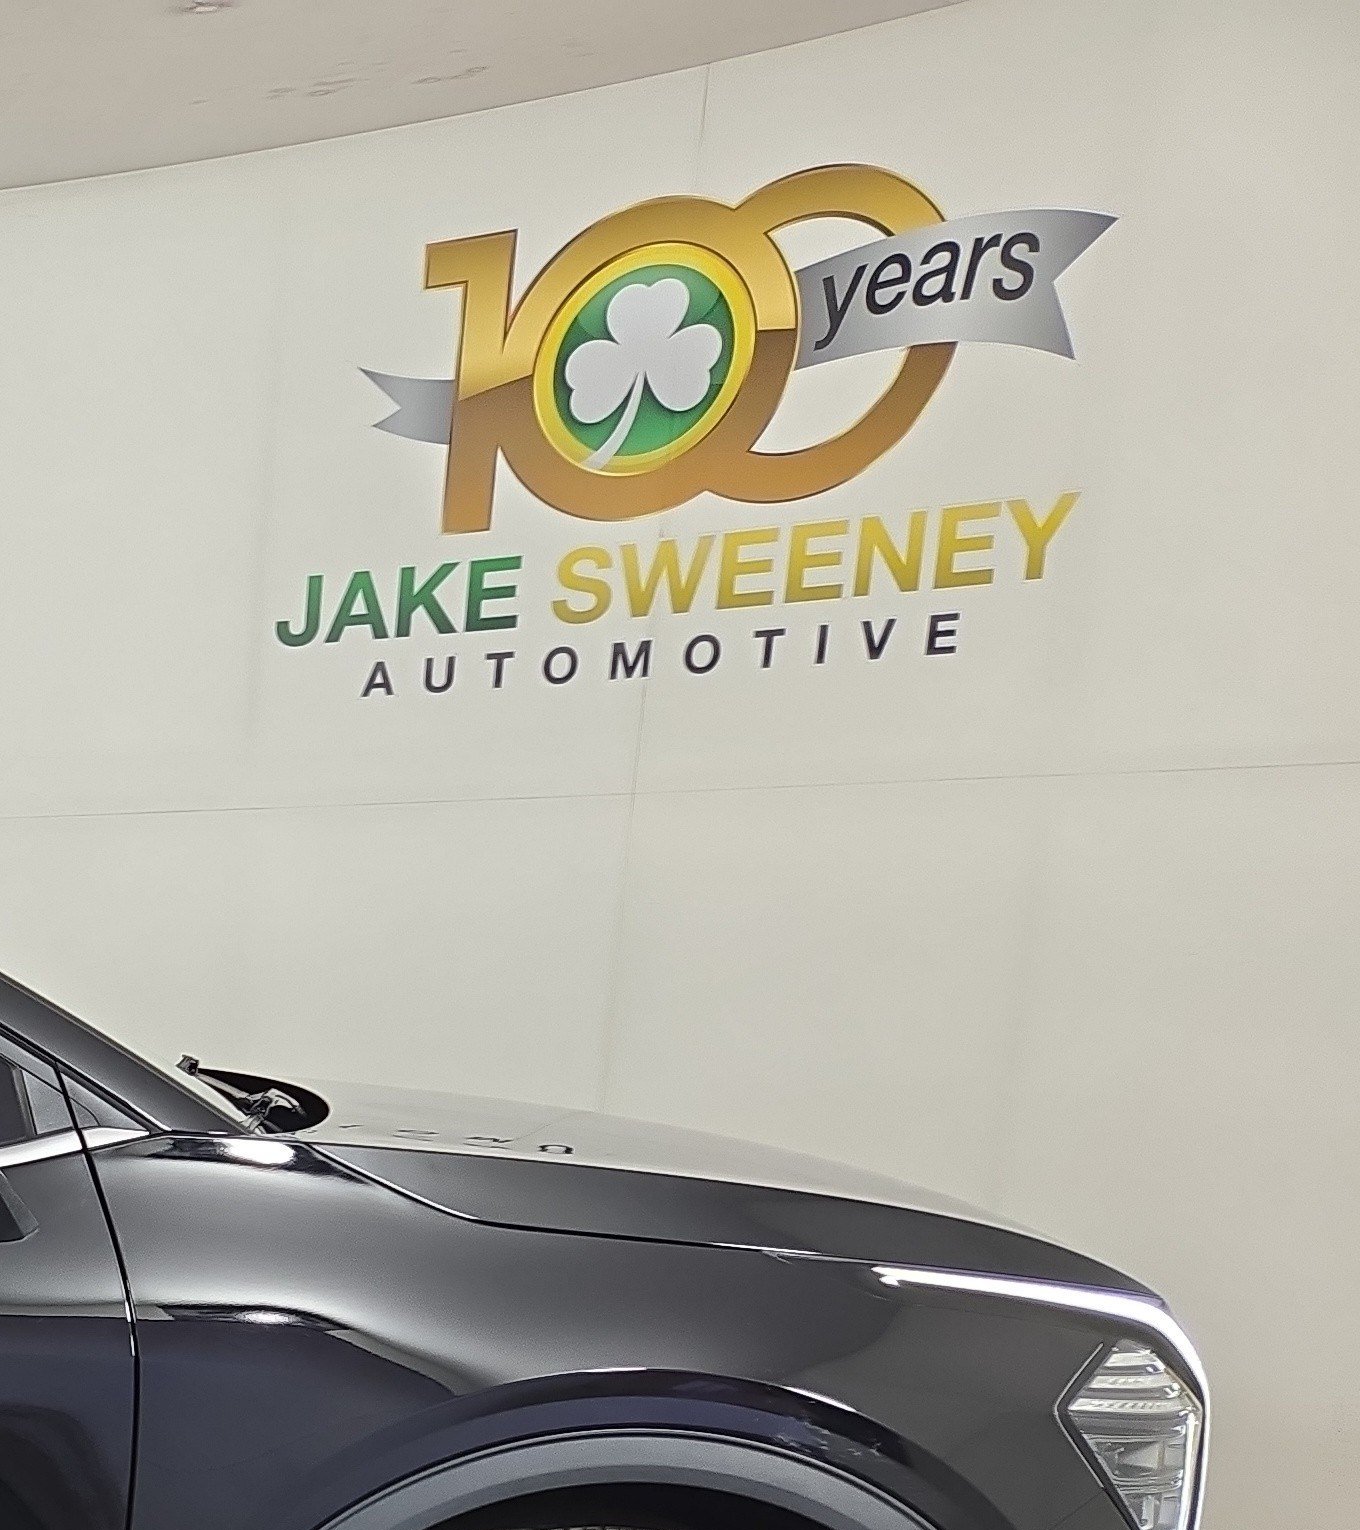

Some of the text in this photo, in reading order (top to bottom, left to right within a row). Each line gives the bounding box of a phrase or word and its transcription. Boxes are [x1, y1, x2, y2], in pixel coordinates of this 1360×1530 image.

[426, 163, 1040, 535] 100 years
[275, 491, 1082, 647] JAKE SWEENEY
[361, 612, 962, 698] AUTOMOTIVE
